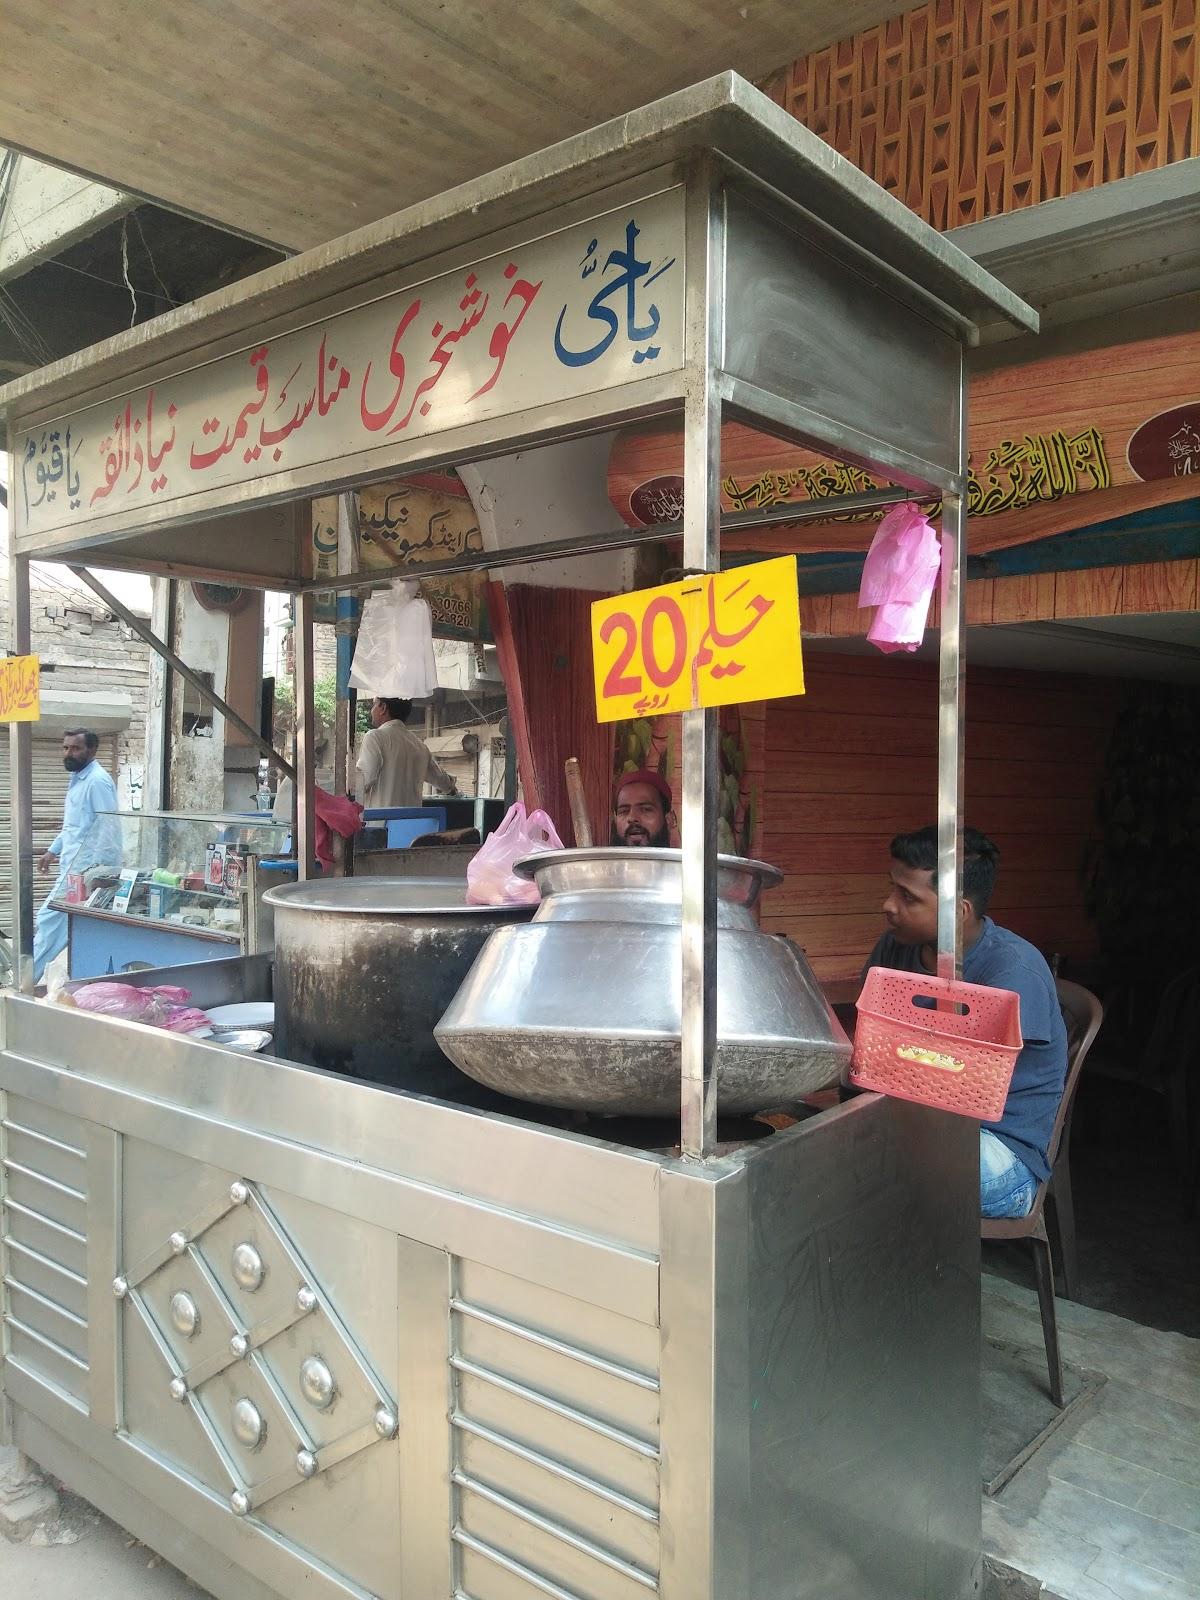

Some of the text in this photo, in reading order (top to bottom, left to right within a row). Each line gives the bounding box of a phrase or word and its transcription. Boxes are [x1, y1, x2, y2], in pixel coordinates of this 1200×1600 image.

[190, 346, 269, 470] قیمت
[599, 595, 688, 699] 20
[632, 693, 670, 717] روپے
